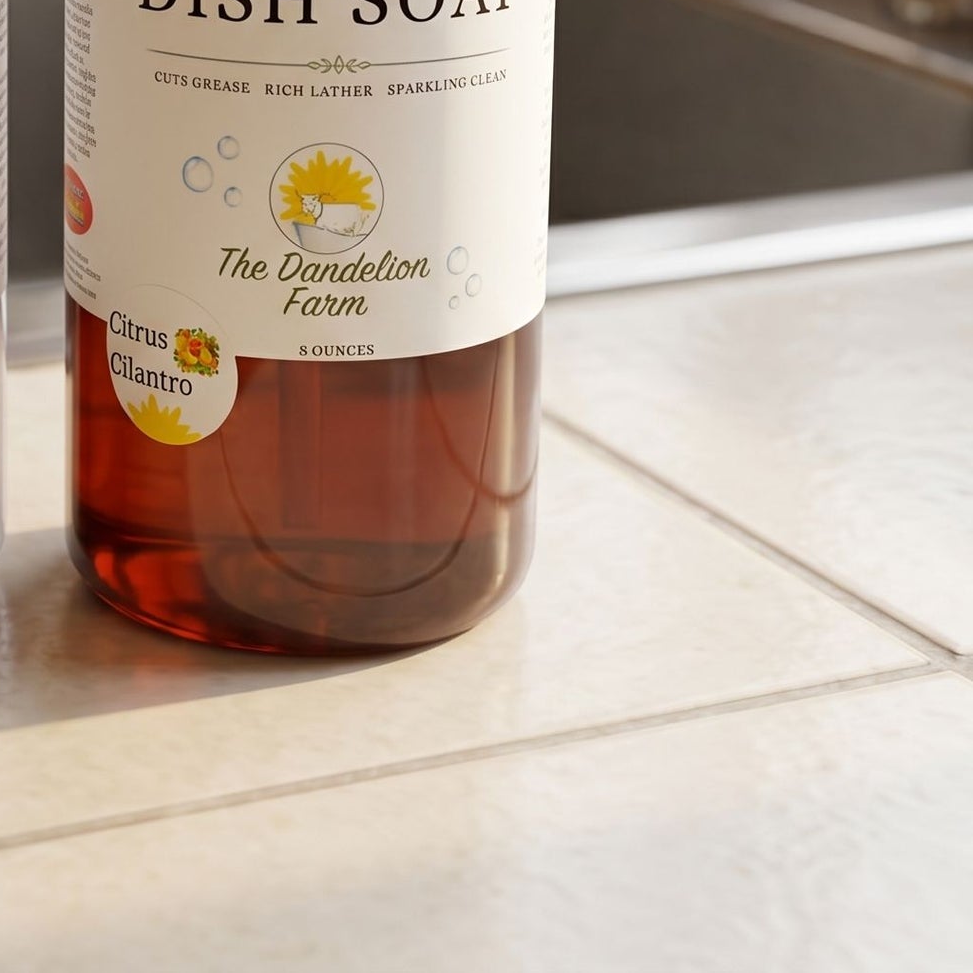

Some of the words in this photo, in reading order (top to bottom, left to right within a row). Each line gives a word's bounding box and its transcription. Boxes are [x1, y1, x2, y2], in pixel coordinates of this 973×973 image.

[154, 70, 188, 87] CUTS
[191, 76, 251, 94] GREASE
[264, 83, 304, 97] RICH
[310, 84, 373, 98] LATHER
[387, 76, 467, 96] SPARKLING
[470, 68, 507, 87] CLEAN
[218, 246, 269, 281] The
[277, 247, 431, 284] Dandelion
[282, 286, 369, 317] Farm
[109, 310, 168, 350] Citrus
[298, 345, 308, 357] 8
[311, 343, 375, 357] OUNCES
[109, 351, 193, 397] Cilantro
